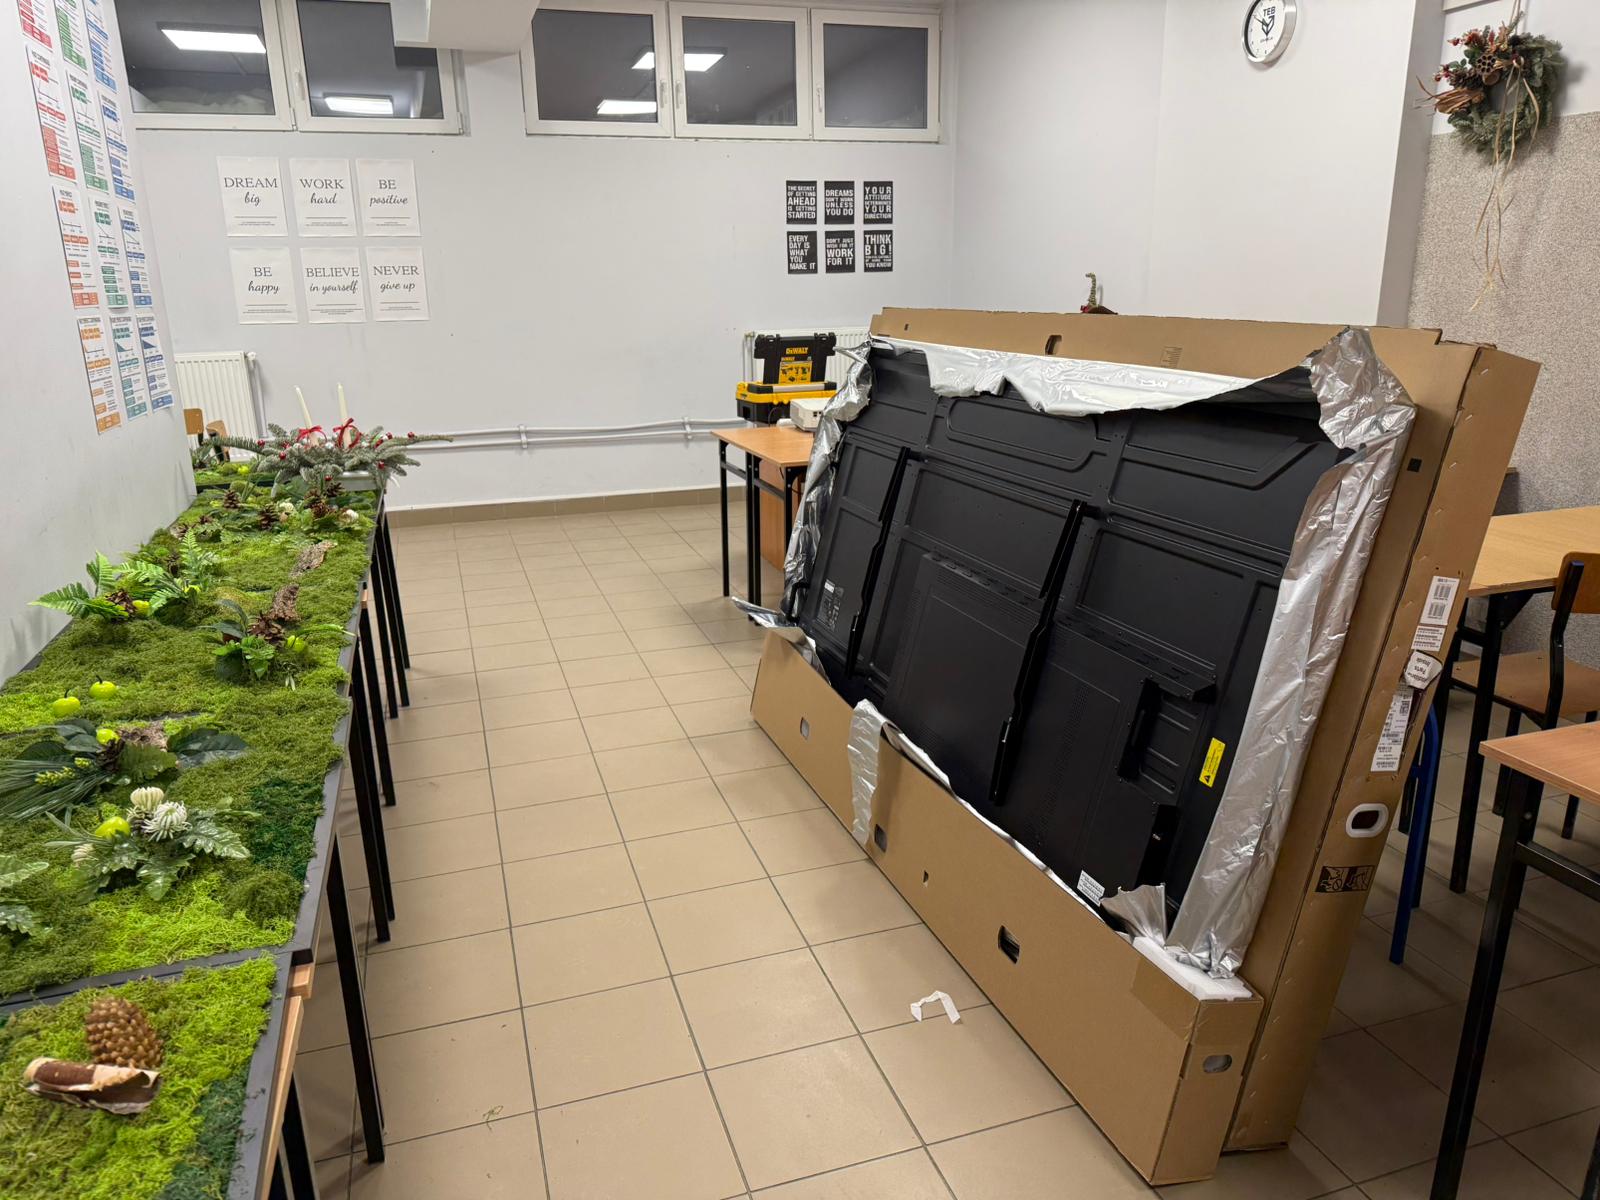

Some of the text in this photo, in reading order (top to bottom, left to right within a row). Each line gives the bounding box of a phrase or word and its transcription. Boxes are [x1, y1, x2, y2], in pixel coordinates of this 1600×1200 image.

[224, 177, 278, 189] DREAM
[299, 178, 345, 190] WORK
[378, 179, 397, 190] BE
[244, 191, 261, 207] big
[310, 193, 337, 205] hard
[369, 193, 408, 207] positive
[788, 197, 816, 206] AHEAD
[865, 234, 892, 244] THINK
[826, 248, 854, 258] WORK
[253, 266, 273, 277] BE
[306, 267, 360, 278] BELIEVE
[373, 266, 420, 276] NEVER
[248, 280, 280, 295] happy
[310, 280, 358, 295] in yourself
[380, 280, 416, 293] give up
